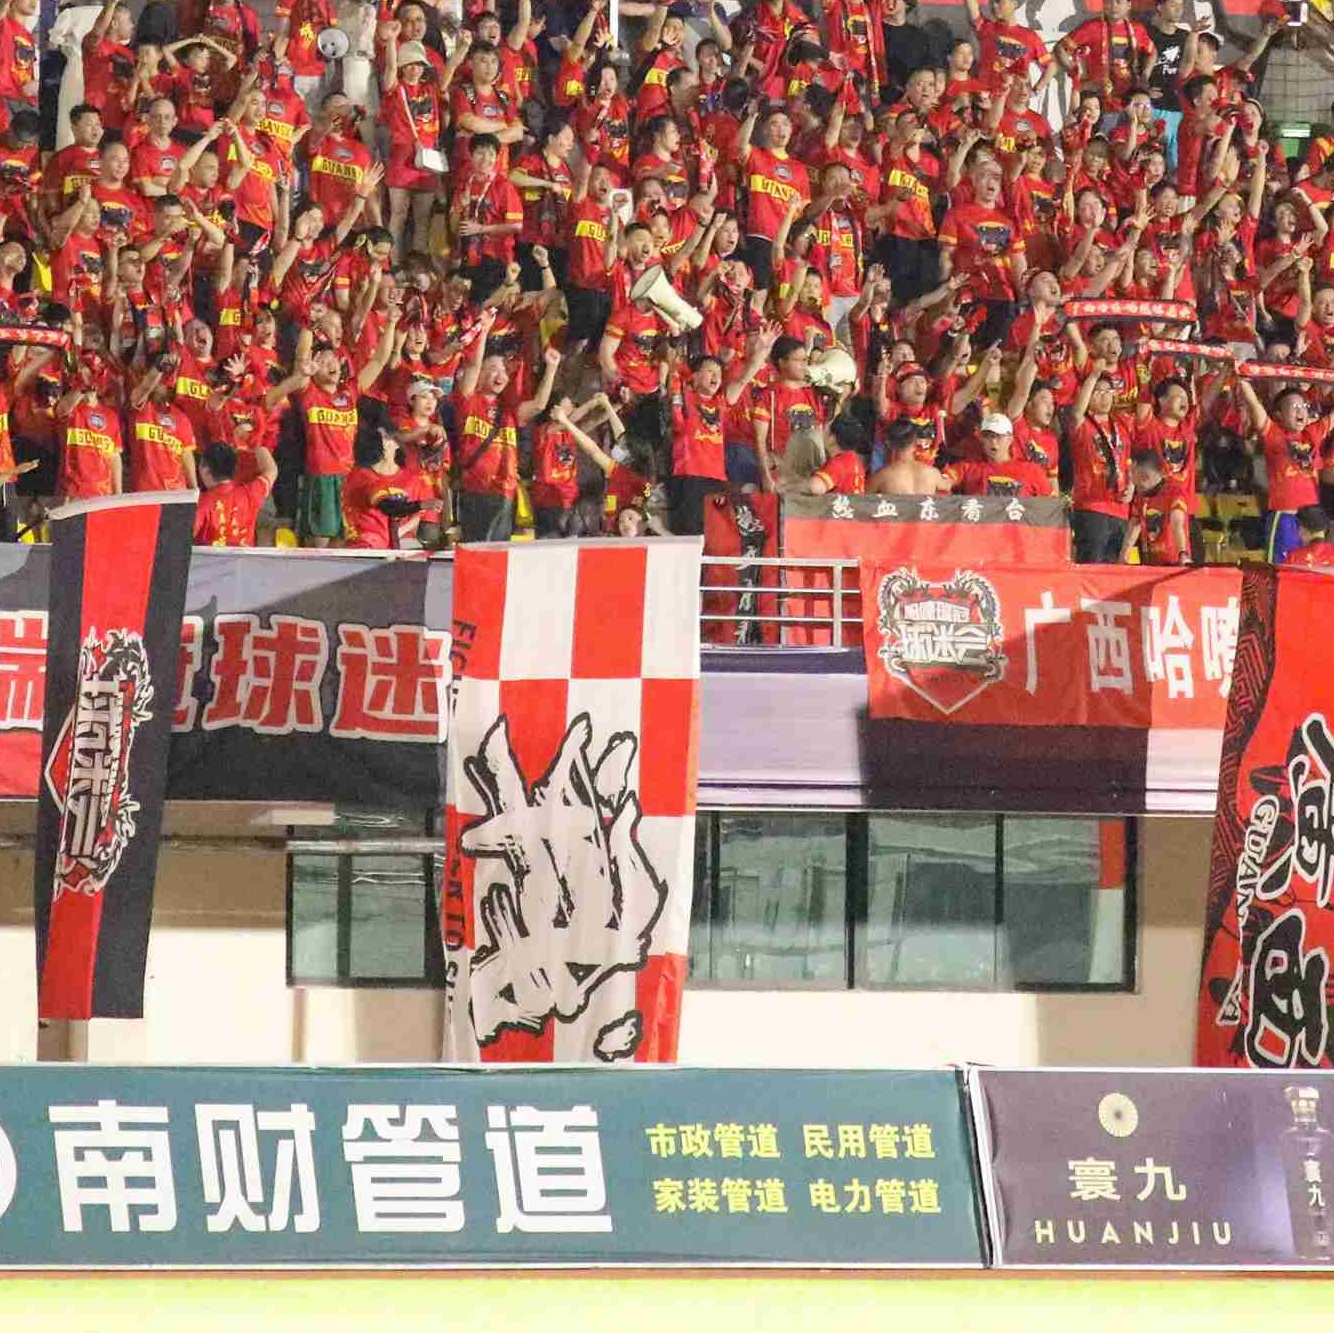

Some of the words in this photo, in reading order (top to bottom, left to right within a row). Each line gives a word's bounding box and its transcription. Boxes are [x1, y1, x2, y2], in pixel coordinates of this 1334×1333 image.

[645, 1122, 781, 1159] 市政管道
[802, 1122, 936, 1159] 民用管道
[48, 1099, 613, 1234] 南财管道
[1068, 1156, 1187, 1202] 寰九
[652, 1177, 789, 1214] 家装管道
[808, 1177, 942, 1214] 电力管道
[1034, 1219, 1233, 1246] HUANJIU
